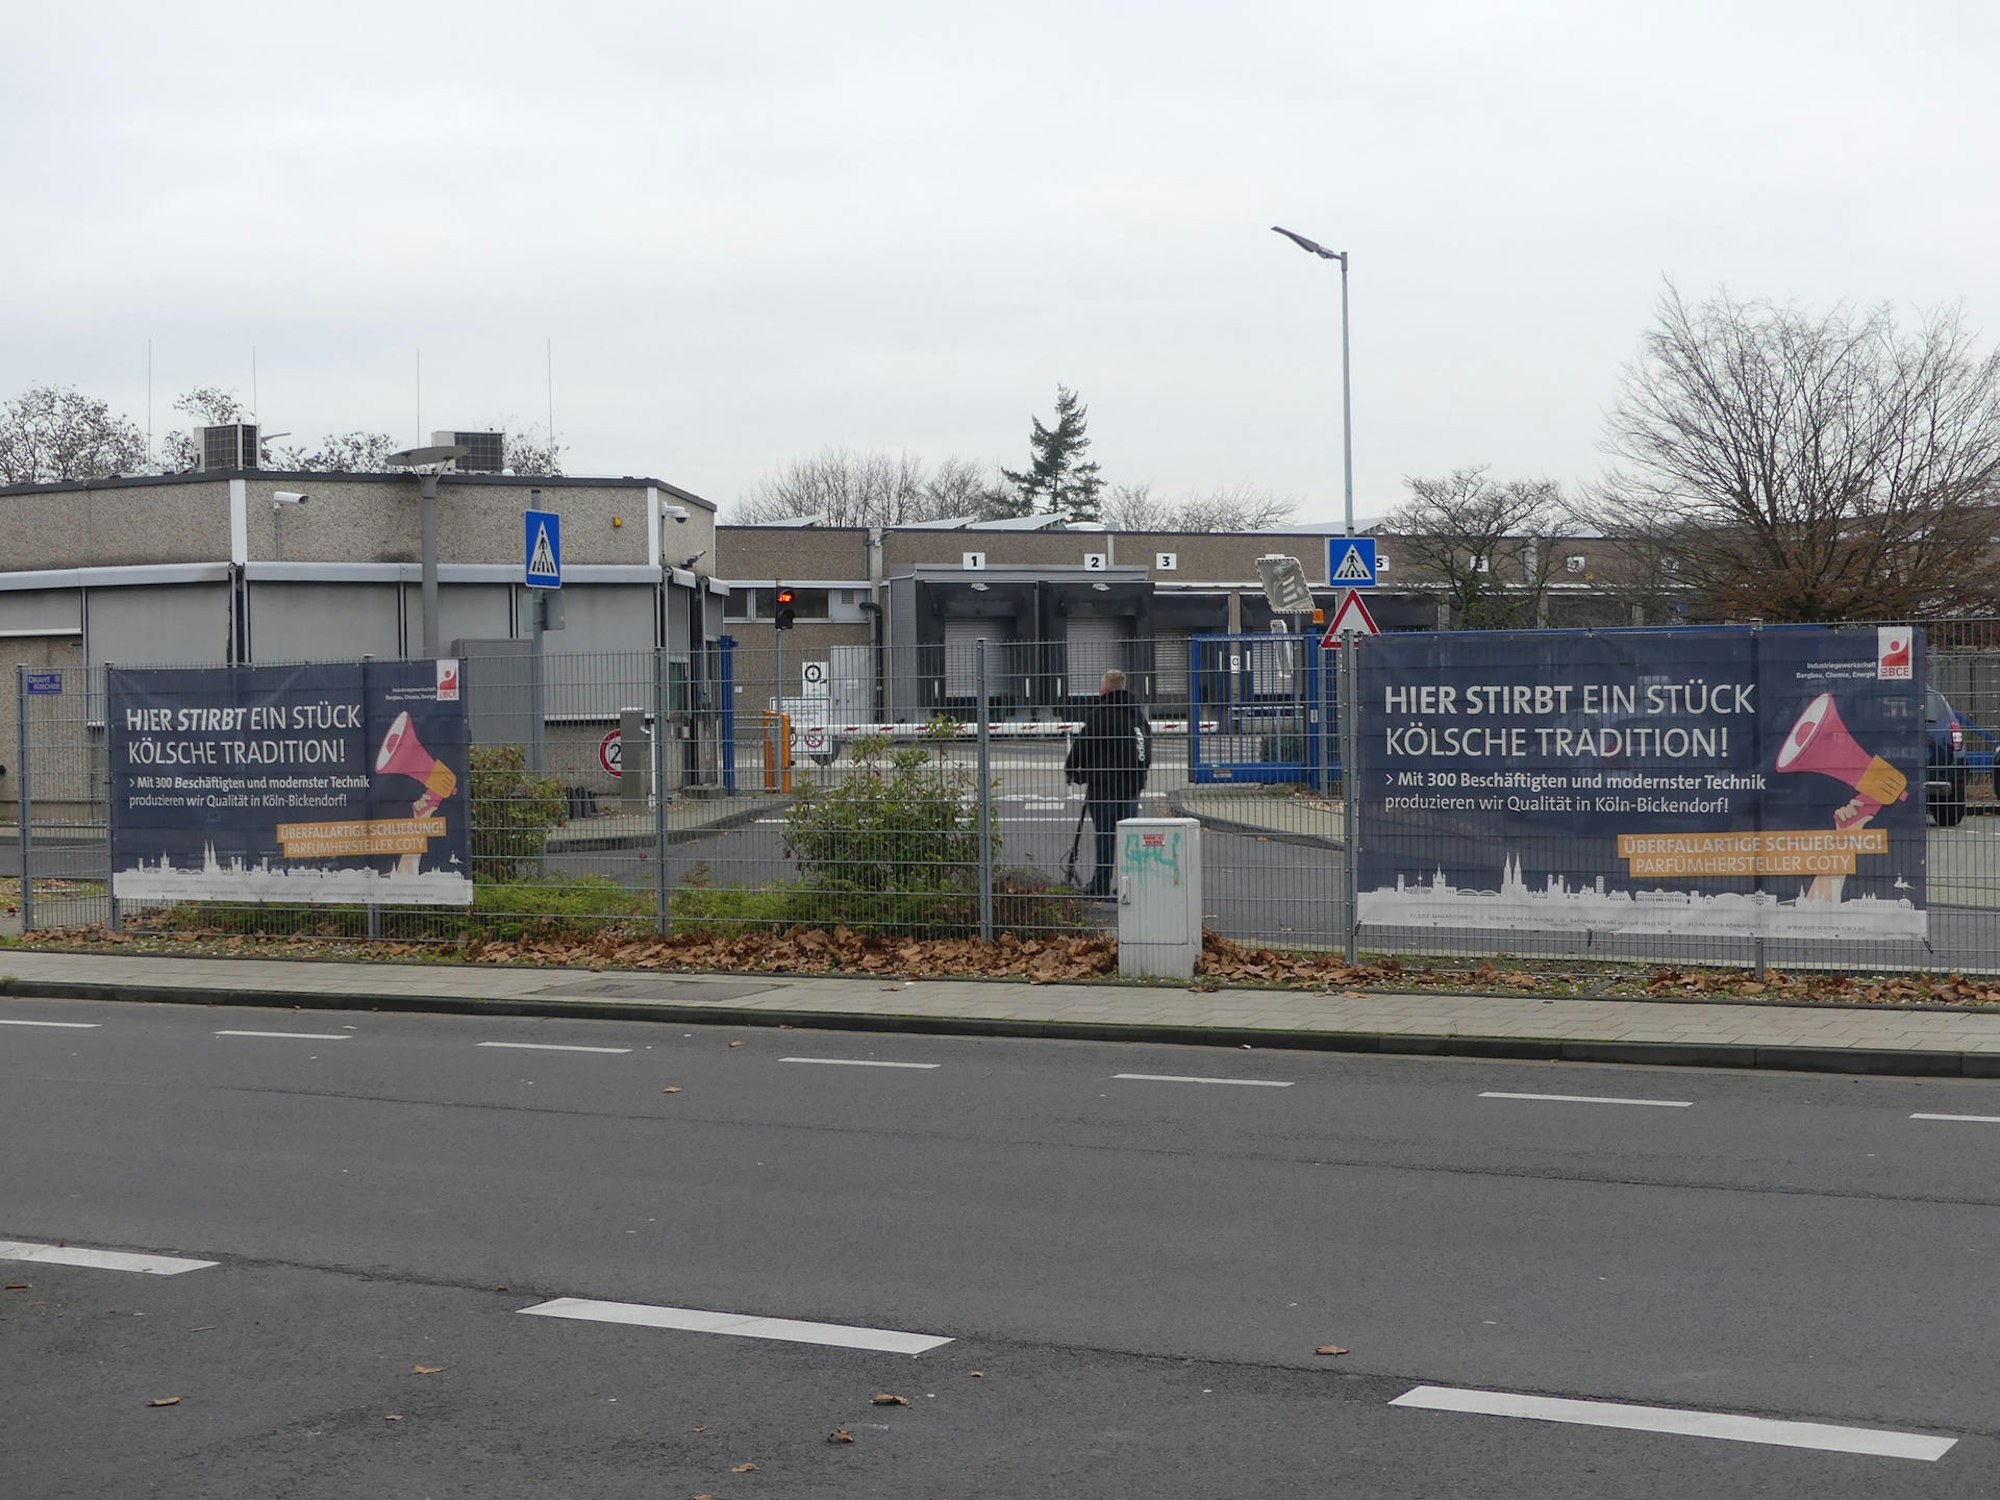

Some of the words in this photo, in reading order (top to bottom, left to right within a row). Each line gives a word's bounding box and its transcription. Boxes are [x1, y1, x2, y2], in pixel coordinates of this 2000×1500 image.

[971, 556, 978, 567] 1
[1091, 557, 1099, 568] 2
[1162, 556, 1170, 567] 3
[1376, 558, 1383, 567] 5
[1807, 662, 1876, 670] Industriegewerkschaft
[1889, 668, 1909, 677] BCE
[1385, 686, 1457, 714] HIER
[1466, 685, 1572, 714] STIRBT
[1584, 685, 1635, 714] EIN
[1647, 679, 1755, 714] STÜCK
[126, 708, 173, 731] HIER
[177, 707, 246, 731] STIRBT
[251, 705, 286, 730] EIN
[293, 700, 361, 729] STÜCK
[1385, 721, 1526, 757] KÖLSCHE
[1535, 727, 1728, 758] TRADITION!
[129, 737, 217, 764] KÖLSCHE
[220, 739, 345, 764] TRADITION!
[137, 777, 154, 788] Mit
[156, 777, 172, 788] 300
[175, 776, 245, 792] Beschäftigten
[247, 777, 266, 788] und
[269, 776, 329, 789] modernster
[330, 776, 370, 788] Technik
[1398, 772, 1423, 787] Mit
[1428, 773, 1456, 787] 300
[1461, 773, 1567, 792] Beschäftigten
[1571, 773, 1601, 788] und
[1607, 774, 1701, 790] modernster
[1704, 775, 1766, 790] Technik
[129, 795, 185, 809] produzieren
[186, 796, 205, 807] wir
[206, 795, 249, 808] Qualität
[251, 795, 260, 807] in
[262, 794, 347, 807] Köln-Bickendorf!
[1385, 795, 1475, 812] produzieren
[1478, 797, 1504, 811] wir
[1507, 797, 1571, 813] Qualität
[1576, 797, 1591, 811] in
[1595, 797, 1728, 814] Köln-Bickendorf!
[397, 837, 424, 851] COTY
[1624, 836, 1760, 854] ÜBERFALLARTIGE
[1636, 855, 1800, 873] PARFÜMHERSTELLER
[1806, 855, 1850, 871] COTY
